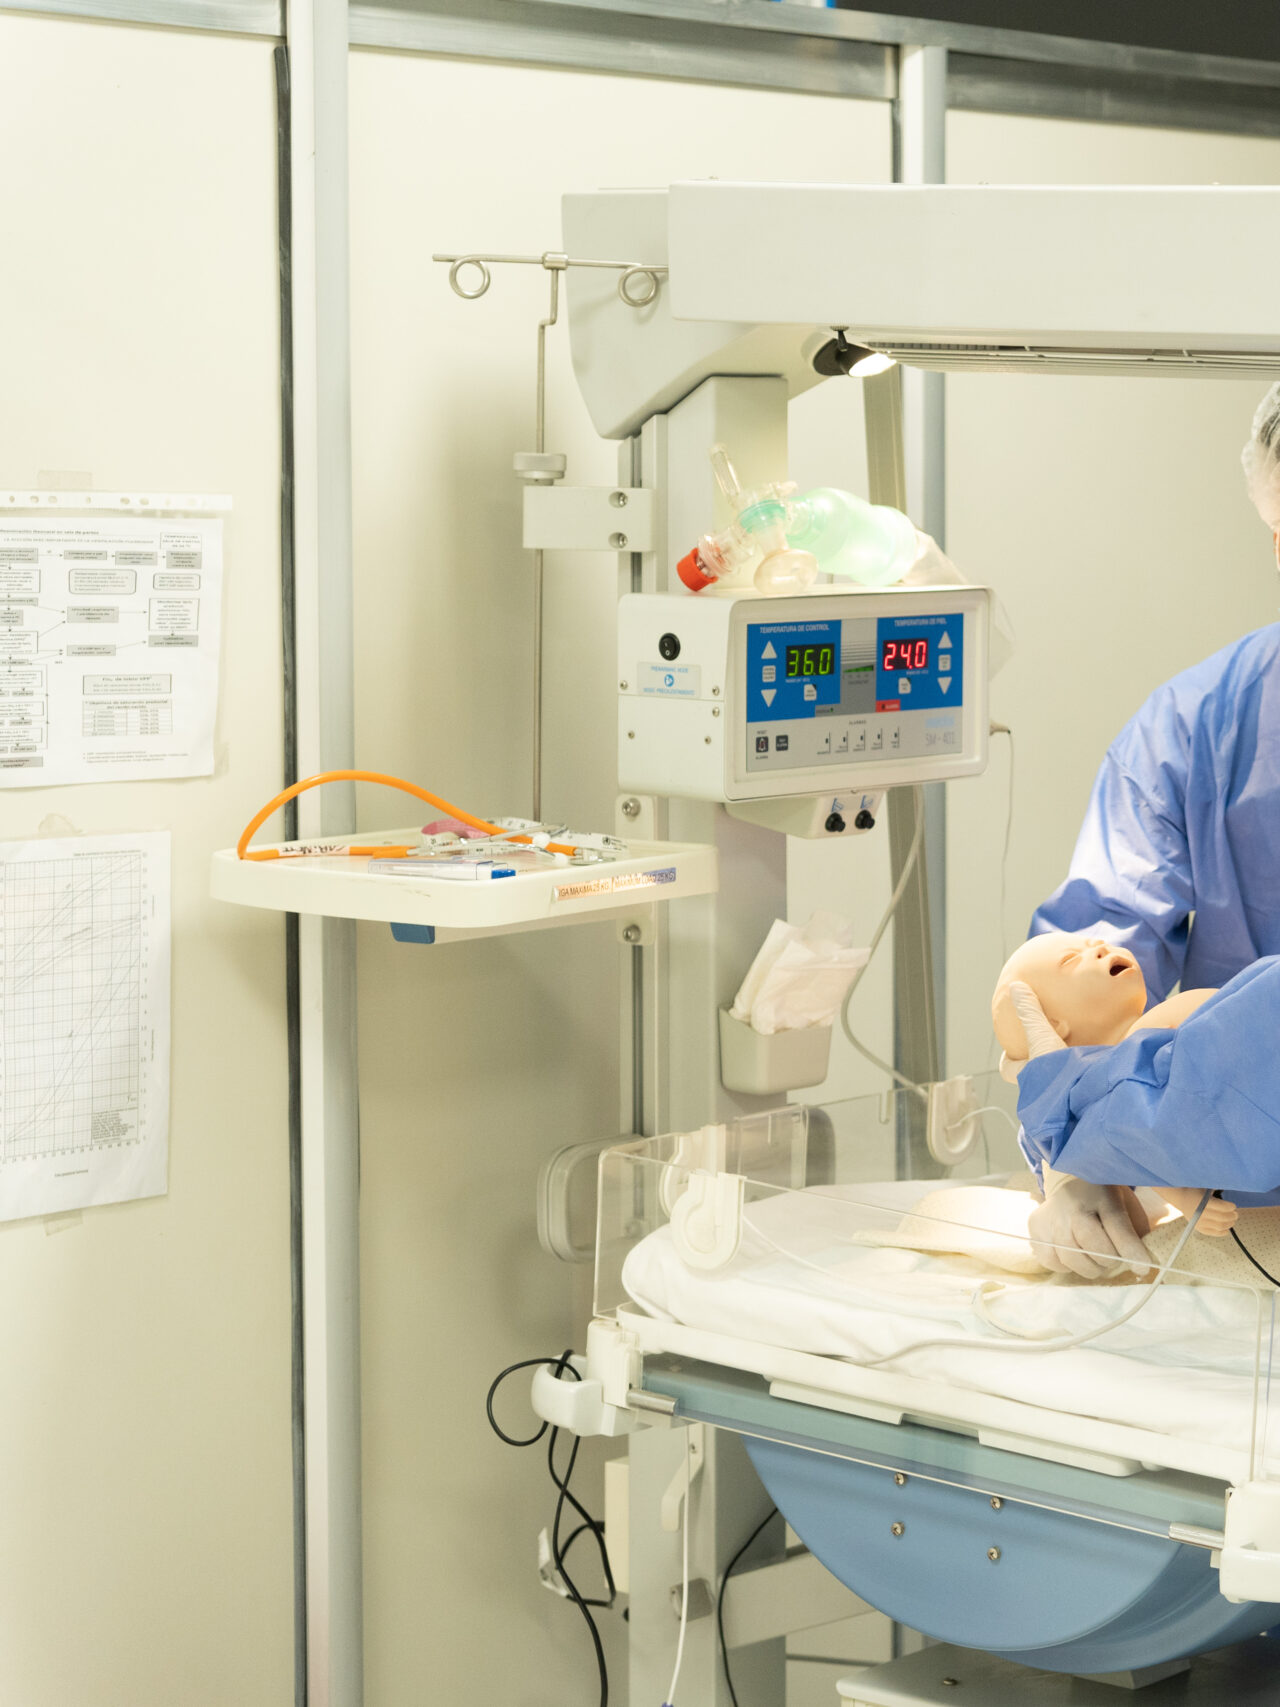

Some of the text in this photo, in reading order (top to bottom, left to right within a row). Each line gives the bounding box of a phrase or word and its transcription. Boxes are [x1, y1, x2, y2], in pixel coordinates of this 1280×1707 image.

[760, 623, 830, 633] TEMPERATURA DE CONTROL
[788, 648, 832, 677] 36.0
[884, 641, 927, 671] 24.0
